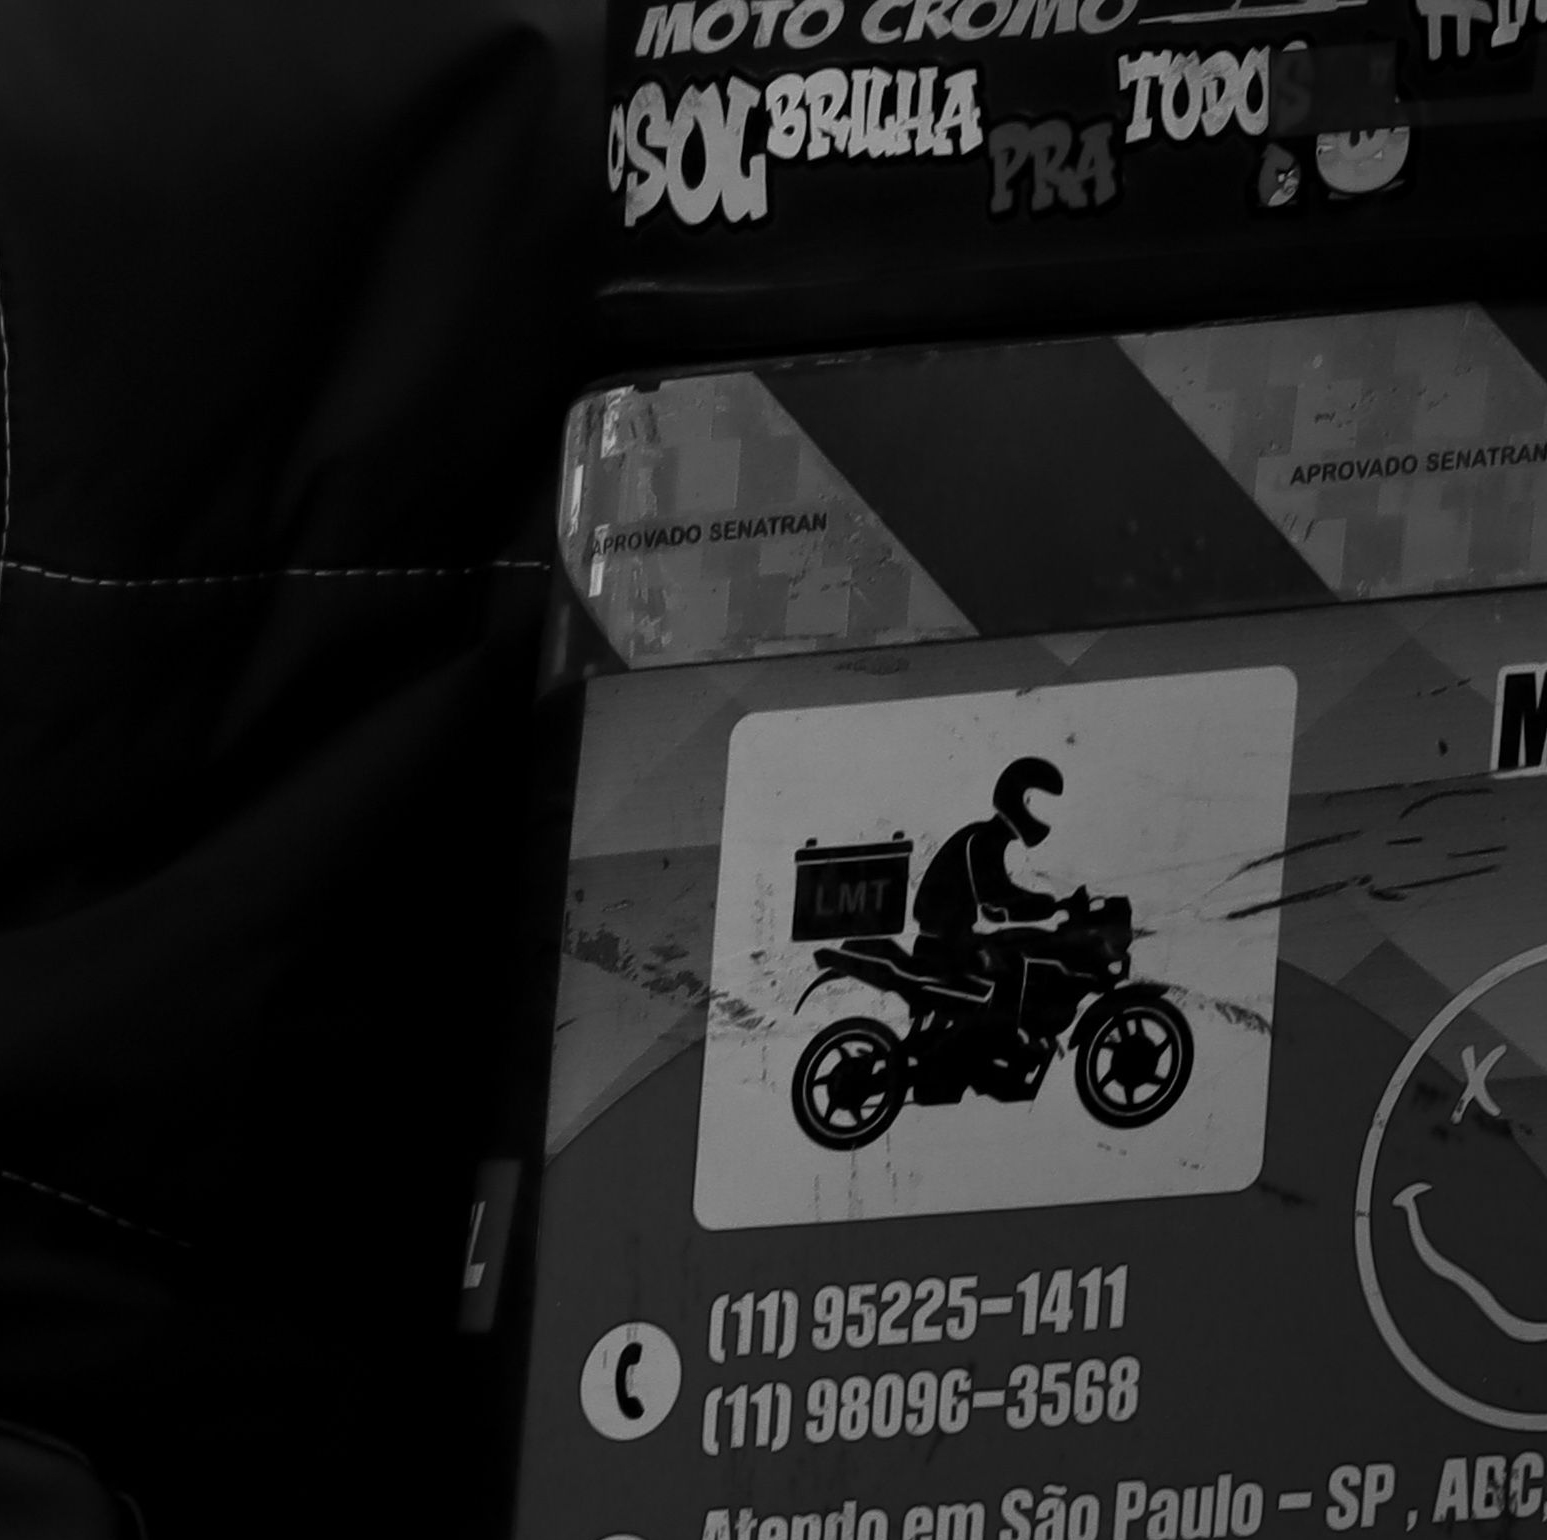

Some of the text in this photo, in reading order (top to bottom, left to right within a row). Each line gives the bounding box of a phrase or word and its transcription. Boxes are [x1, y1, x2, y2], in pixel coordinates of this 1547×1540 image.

[624, 75, 769, 230] SOL
[764, 63, 985, 162] BRILHA
[987, 120, 1120, 219] PRA
[1290, 439, 1547, 486] APROVADO SENATRAN
[591, 513, 828, 557] APROVADO SENATRAN
[814, 877, 893, 917] LMT
[708, 1264, 1129, 1364] (11) 95225-1411
[701, 1355, 1142, 1457] (11) 98096-3568
[1325, 1461, 1396, 1531] SP
